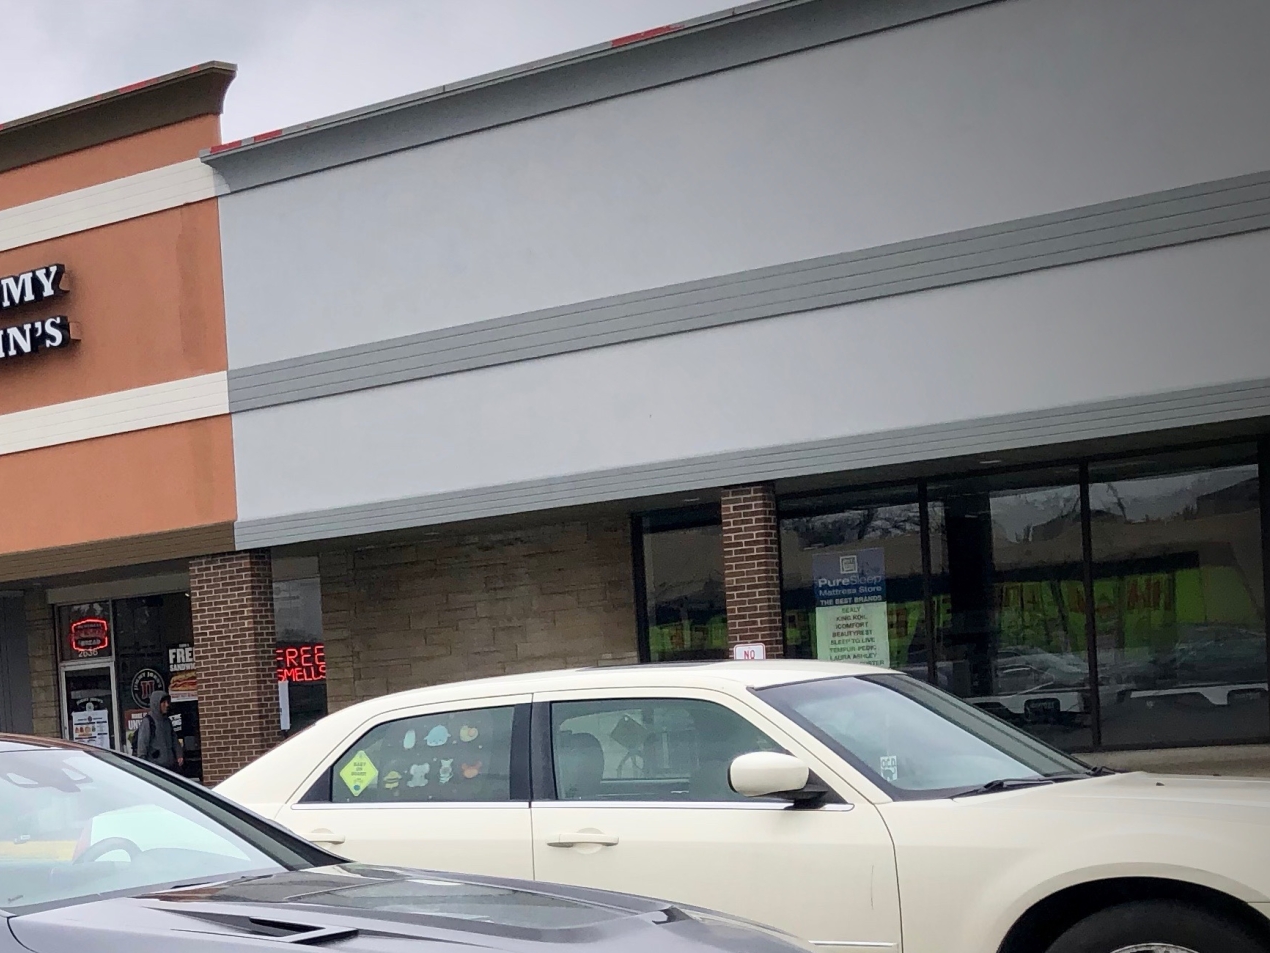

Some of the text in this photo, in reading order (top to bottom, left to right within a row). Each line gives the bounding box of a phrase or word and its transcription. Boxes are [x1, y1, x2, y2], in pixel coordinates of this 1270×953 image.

[818, 575, 882, 588] PureSleep
[819, 585, 883, 596] Mattress Store
[835, 597, 853, 605] BEST
[854, 595, 883, 603] BRANDS
[841, 605, 862, 613] SEALY
[831, 630, 873, 638] BEAUTYREST
[830, 639, 850, 647] SLEEP
